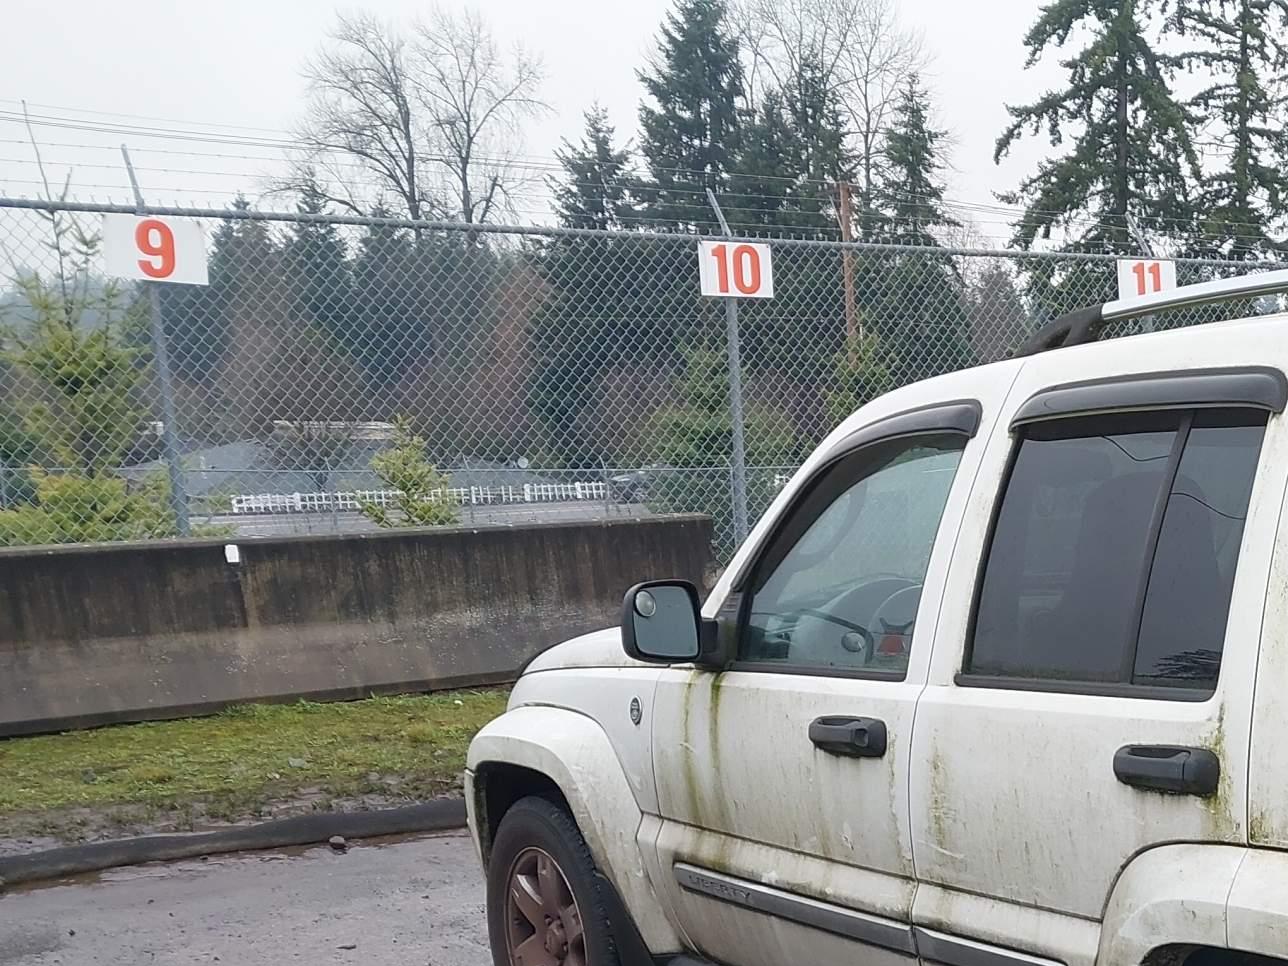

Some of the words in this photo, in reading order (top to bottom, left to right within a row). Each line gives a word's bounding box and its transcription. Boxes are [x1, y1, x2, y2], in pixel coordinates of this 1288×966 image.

[135, 219, 176, 278] 9
[711, 244, 761, 294] 10
[1132, 262, 1161, 296] 11
